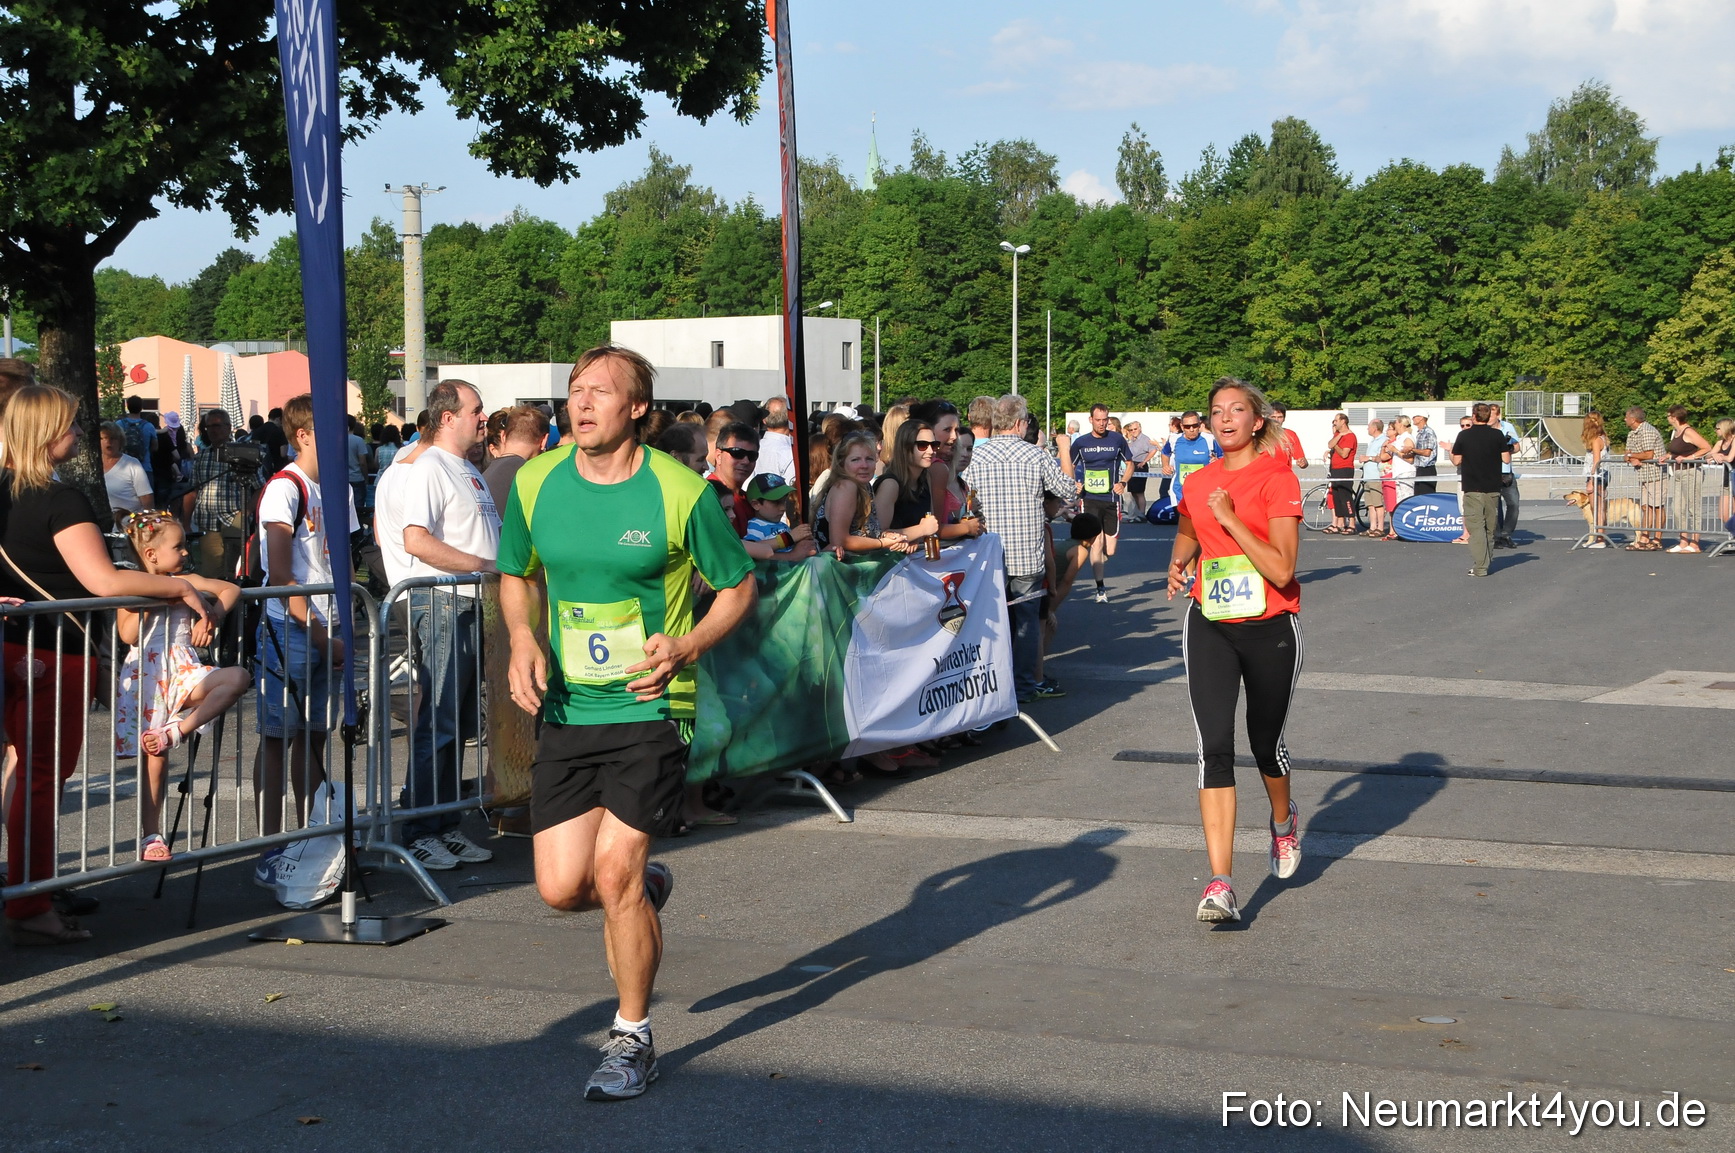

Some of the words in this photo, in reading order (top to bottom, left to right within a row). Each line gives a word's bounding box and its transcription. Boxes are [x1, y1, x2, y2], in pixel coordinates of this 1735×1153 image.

[1088, 478, 1105, 487] 344
[619, 530, 651, 544] AOK
[1208, 576, 1253, 604] 494
[588, 632, 610, 665] 6
[919, 664, 998, 716] Lammsbräu
